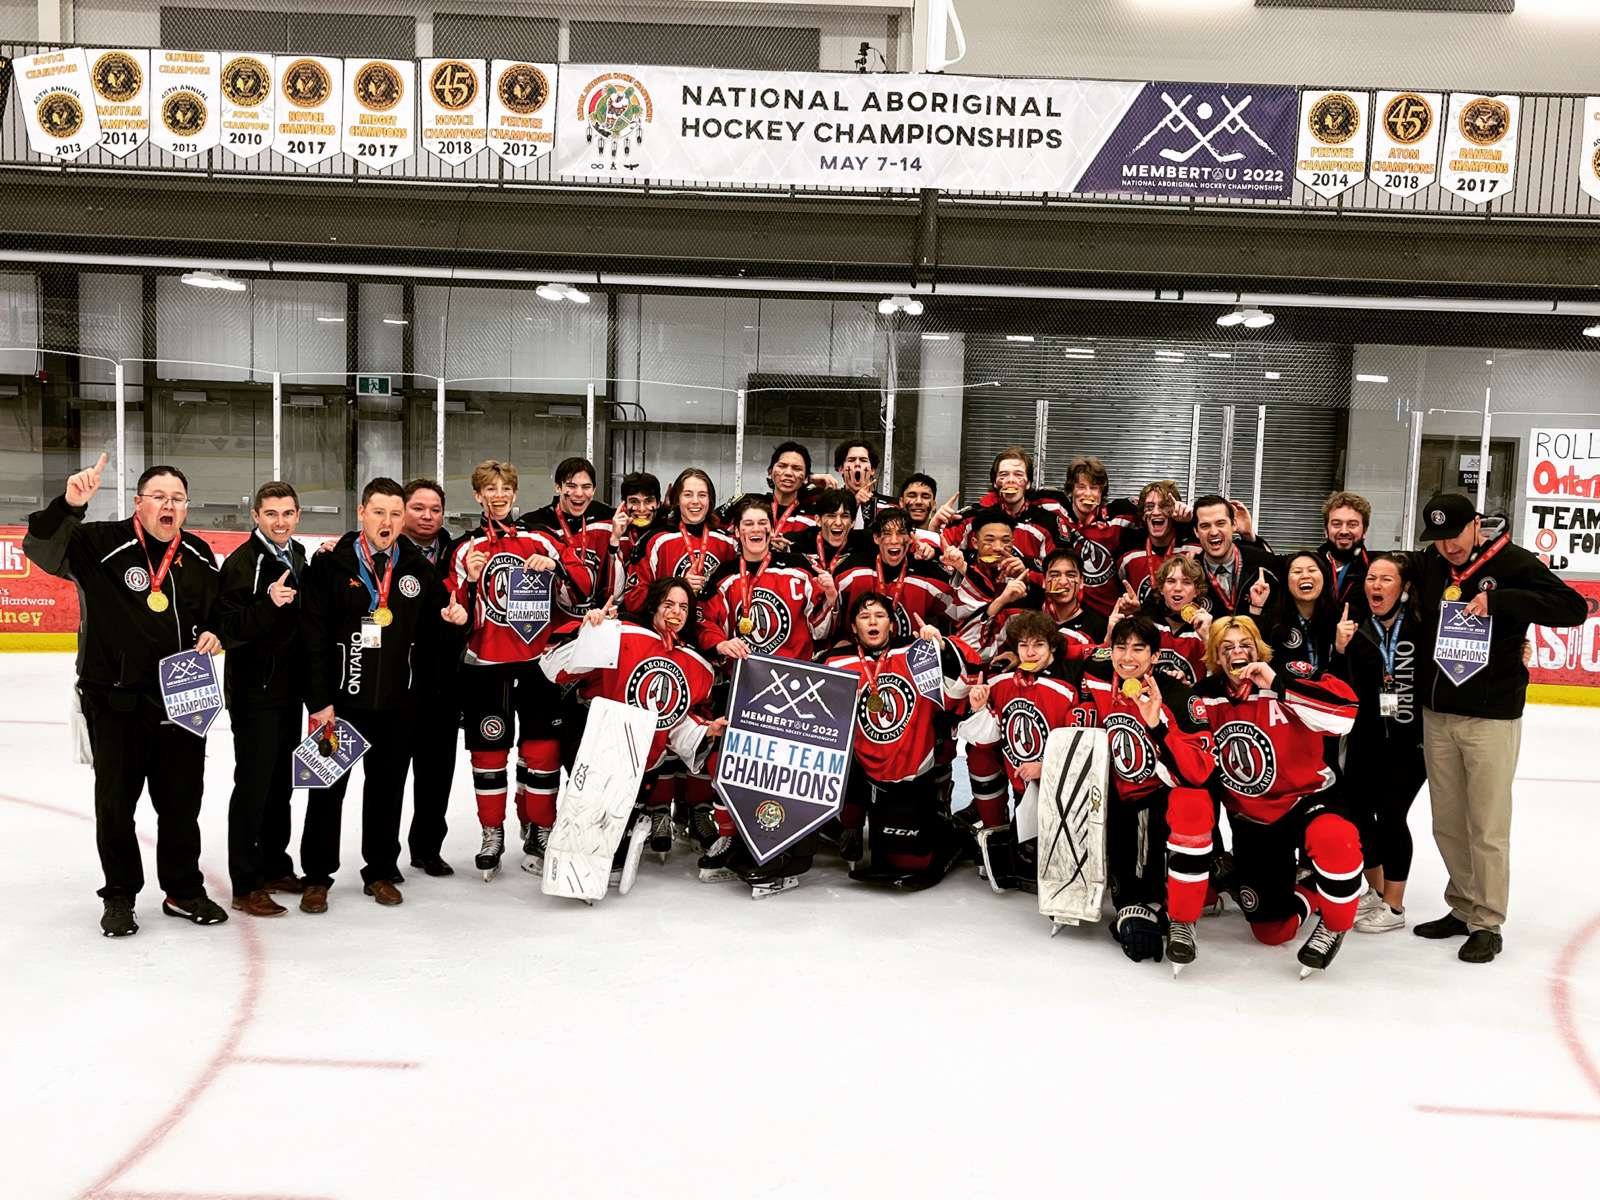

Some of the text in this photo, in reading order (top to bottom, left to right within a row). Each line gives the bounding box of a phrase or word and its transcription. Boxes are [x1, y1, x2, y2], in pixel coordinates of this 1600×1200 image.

[50, 86, 80, 98] ANNUAL
[180, 84, 208, 100] ANNUAL
[435, 65, 470, 105] 45
[682, 85, 849, 112] NATIONAL
[861, 91, 1062, 117] ABORIGINAL
[288, 111, 325, 122] NOVICE
[359, 113, 397, 125] MIDGET
[435, 115, 473, 125] NOVICE
[500, 116, 543, 128] PEEWEE
[1388, 99, 1425, 140] 45
[279, 123, 336, 135] CHAMPIONS
[349, 125, 407, 138] CHAMPIONS
[424, 128, 487, 139] CHAMPIONS
[489, 128, 552, 143] CHAMPIONS
[681, 117, 1062, 149] HOCKEY CHAMPIONSHIPS
[102, 132, 137, 144] 2014
[230, 132, 262, 145] 2010
[56, 143, 81, 155] 2013
[172, 143, 197, 152] 2013
[287, 141, 326, 154] 2017
[358, 143, 398, 157] 2017
[438, 141, 472, 154] 2018
[502, 142, 537, 156] 2012
[1310, 147, 1354, 158] PEEWEE
[1388, 147, 1420, 159] ATOM
[1459, 148, 1502, 160] BANTAM
[820, 155, 922, 171] MAY 7-14
[1298, 160, 1364, 172] CHAMPIONS
[1372, 160, 1434, 174] CHAMPIONS
[1449, 160, 1509, 173] CHAMPIONS
[1122, 165, 1284, 182] MEMBERTOU 2022
[1312, 173, 1348, 187] 2014
[1228, 183, 1283, 192] CHAMPIONSHIPS
[1384, 174, 1419, 189] 2018
[1456, 178, 1499, 192] 2017
[1536, 432, 1600, 459] ROLL
[790, 578, 803, 600] C
[1, 596, 56, 606] Hardware
[508, 610, 549, 620] CHAMPIONS
[1438, 638, 1488, 650] MALE TEAM
[1436, 647, 1487, 662] CHAMPIONS
[348, 632, 363, 694] ONTARIO
[643, 661, 685, 685] ABORIGINAL
[1395, 640, 1415, 723] ONTARIO
[165, 685, 217, 704] MALE TEAM
[168, 695, 219, 717] CHAMPIONS
[1269, 699, 1289, 727] A
[740, 710, 839, 737] MEMBERTOU 2022
[726, 731, 845, 775] MALE TEAM
[296, 746, 336, 785] CHAMPIONS
[721, 755, 840, 803] CHAMPIONS
[1220, 773, 1241, 793] TEAM
[883, 827, 920, 836] CCM
